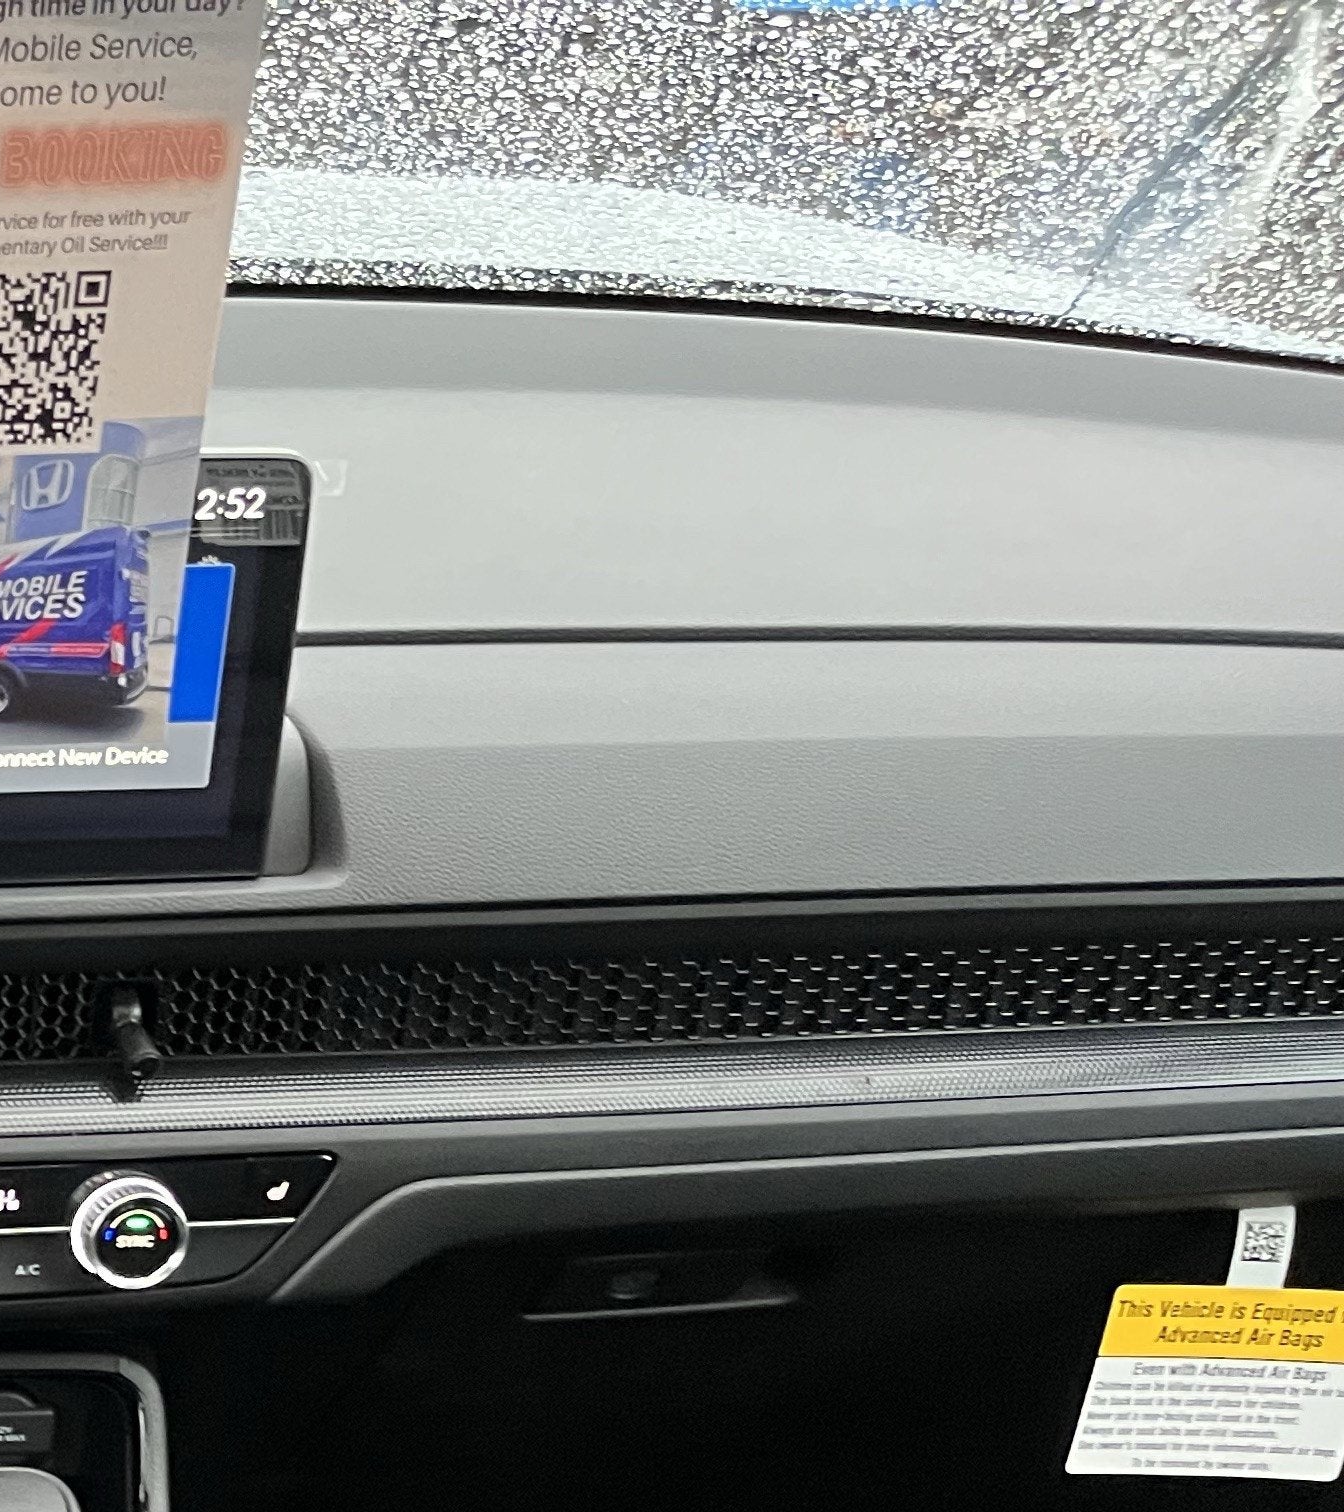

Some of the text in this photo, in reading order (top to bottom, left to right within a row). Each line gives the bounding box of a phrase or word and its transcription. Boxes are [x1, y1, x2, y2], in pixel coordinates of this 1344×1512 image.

[30, 0, 86, 18] time
[92, 0, 115, 16] in
[120, 0, 177, 19] your
[185, 0, 244, 16] day?
[89, 32, 198, 61] Service,
[70, 81, 97, 105] to
[105, 76, 167, 110] you!
[0, 123, 228, 186] BOOKING
[42, 210, 68, 229] for
[70, 208, 105, 227] free
[109, 207, 148, 226] with
[150, 210, 193, 229] your
[61, 235, 85, 254] Oil
[59, 748, 105, 768] New
[107, 745, 170, 767] Device
[14, 1263, 41, 1277] A/C
[1117, 1299, 1153, 1319] This
[1160, 1301, 1224, 1320] Vehicle
[1229, 1302, 1246, 1320] is
[1251, 1303, 1337, 1325] Equipped
[1154, 1325, 1325, 1352] Advanced Air Bags
